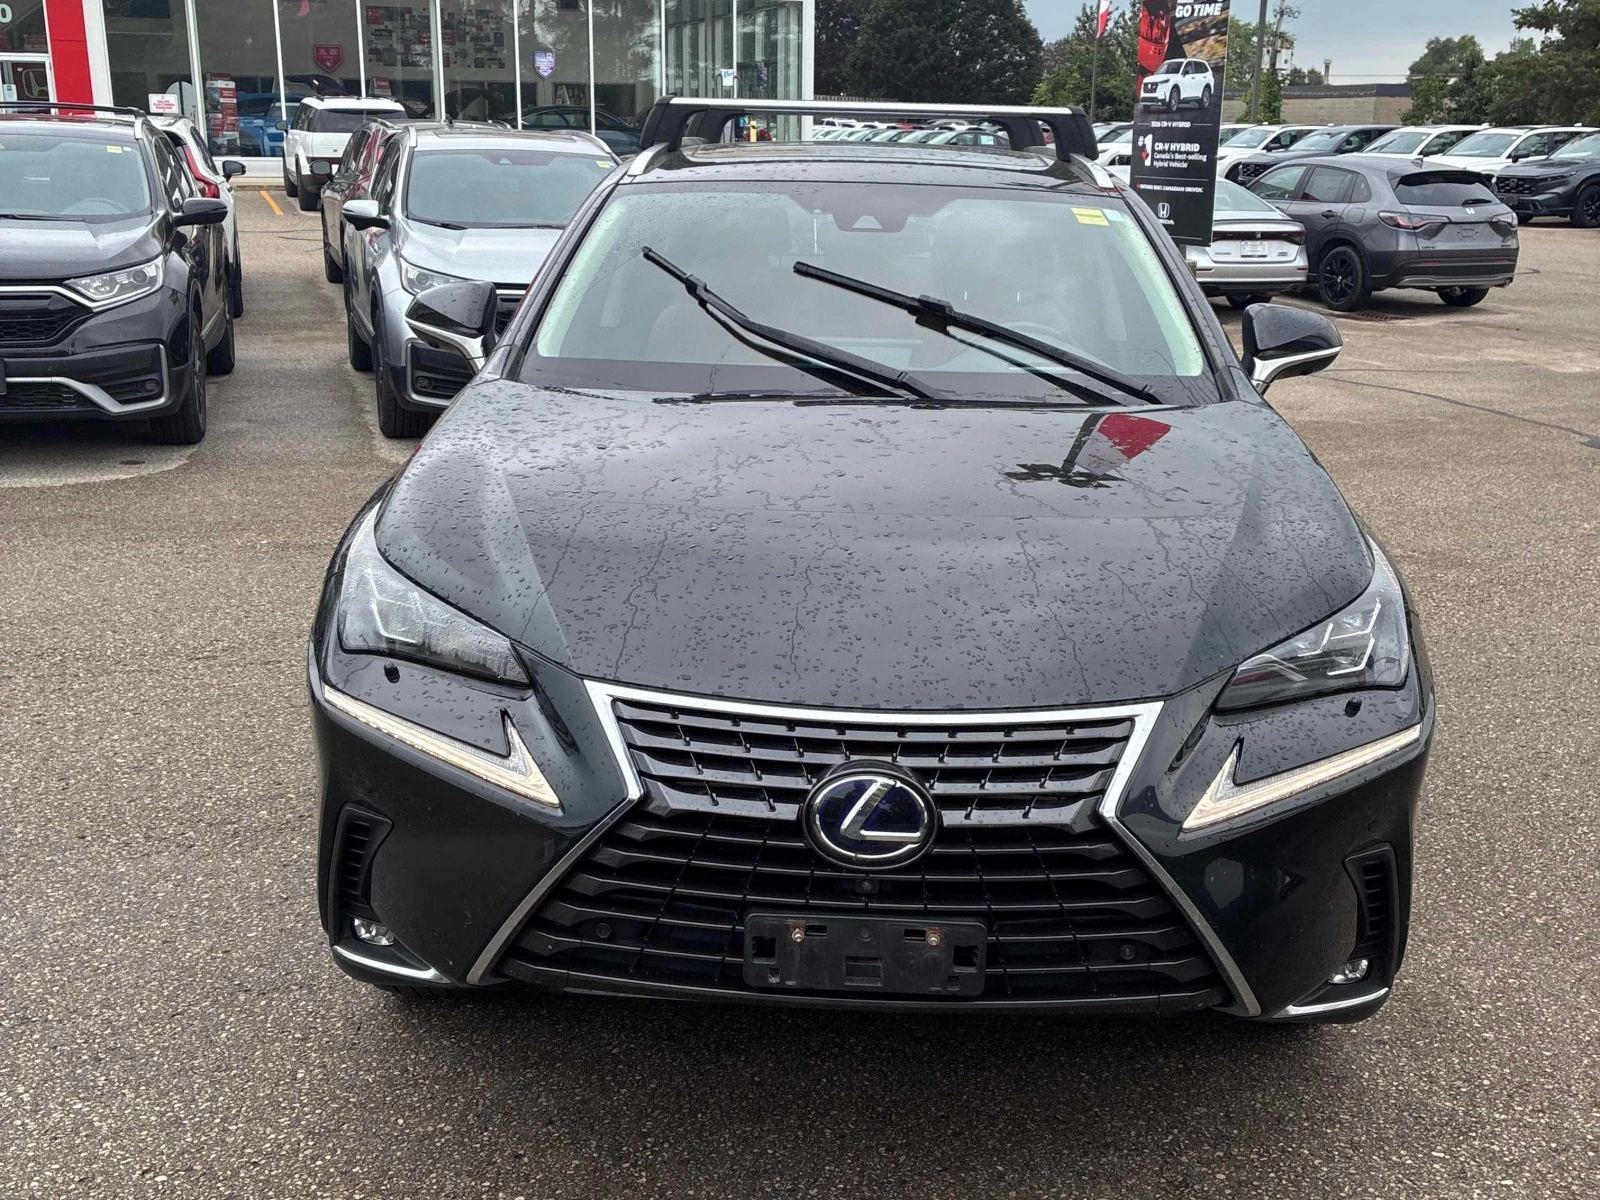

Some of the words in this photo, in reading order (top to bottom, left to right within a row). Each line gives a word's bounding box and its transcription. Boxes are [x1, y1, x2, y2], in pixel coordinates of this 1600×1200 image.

[1175, 5, 1192, 18] GO
[1193, 3, 1223, 17] TIME
[1154, 142, 1170, 151] CR-V
[1170, 143, 1200, 152] HYBRID
[1174, 153, 1207, 162] Best-selling
[1153, 160, 1168, 168] Hybrid
